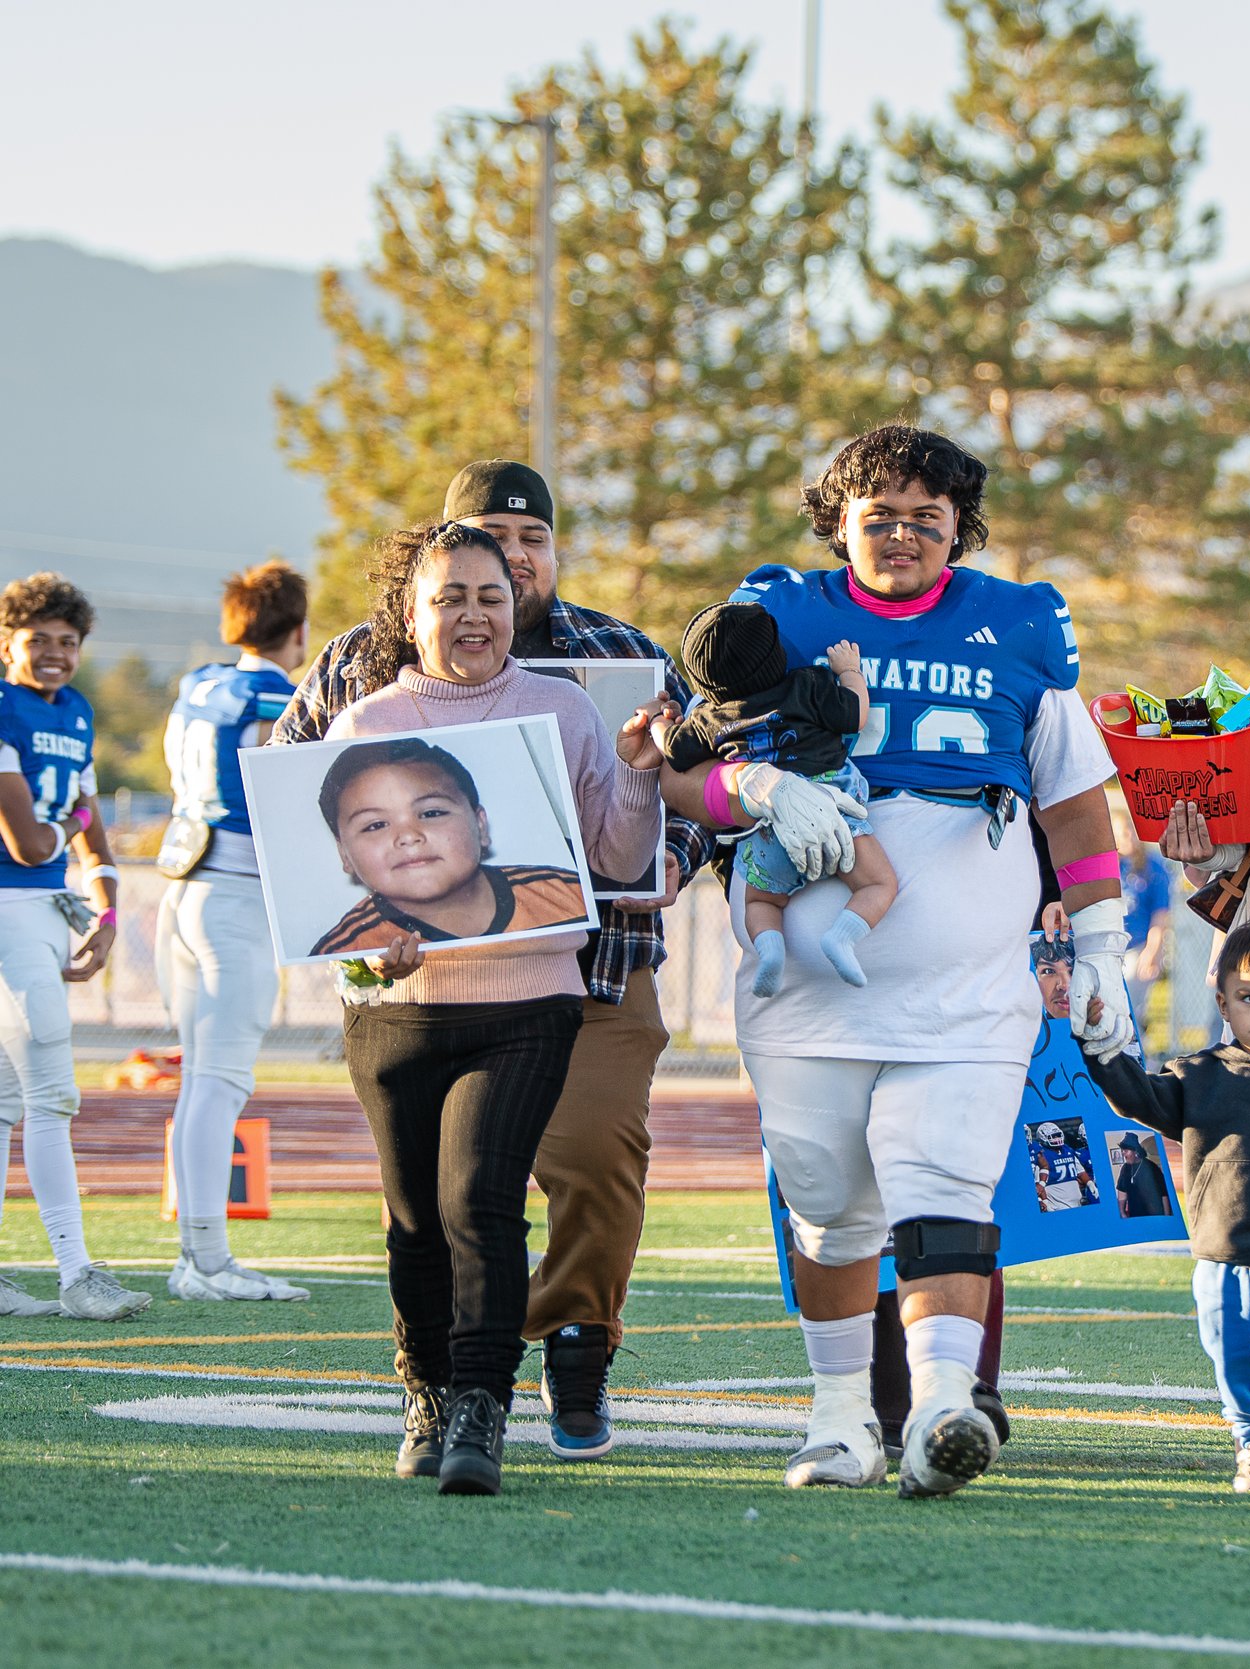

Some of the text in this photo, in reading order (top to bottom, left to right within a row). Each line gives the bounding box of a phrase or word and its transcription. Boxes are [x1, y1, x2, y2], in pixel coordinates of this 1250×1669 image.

[813, 655, 994, 701] NATORS
[1138, 767, 1214, 798] HAPPY
[1131, 789, 1238, 820] HALLEEN
